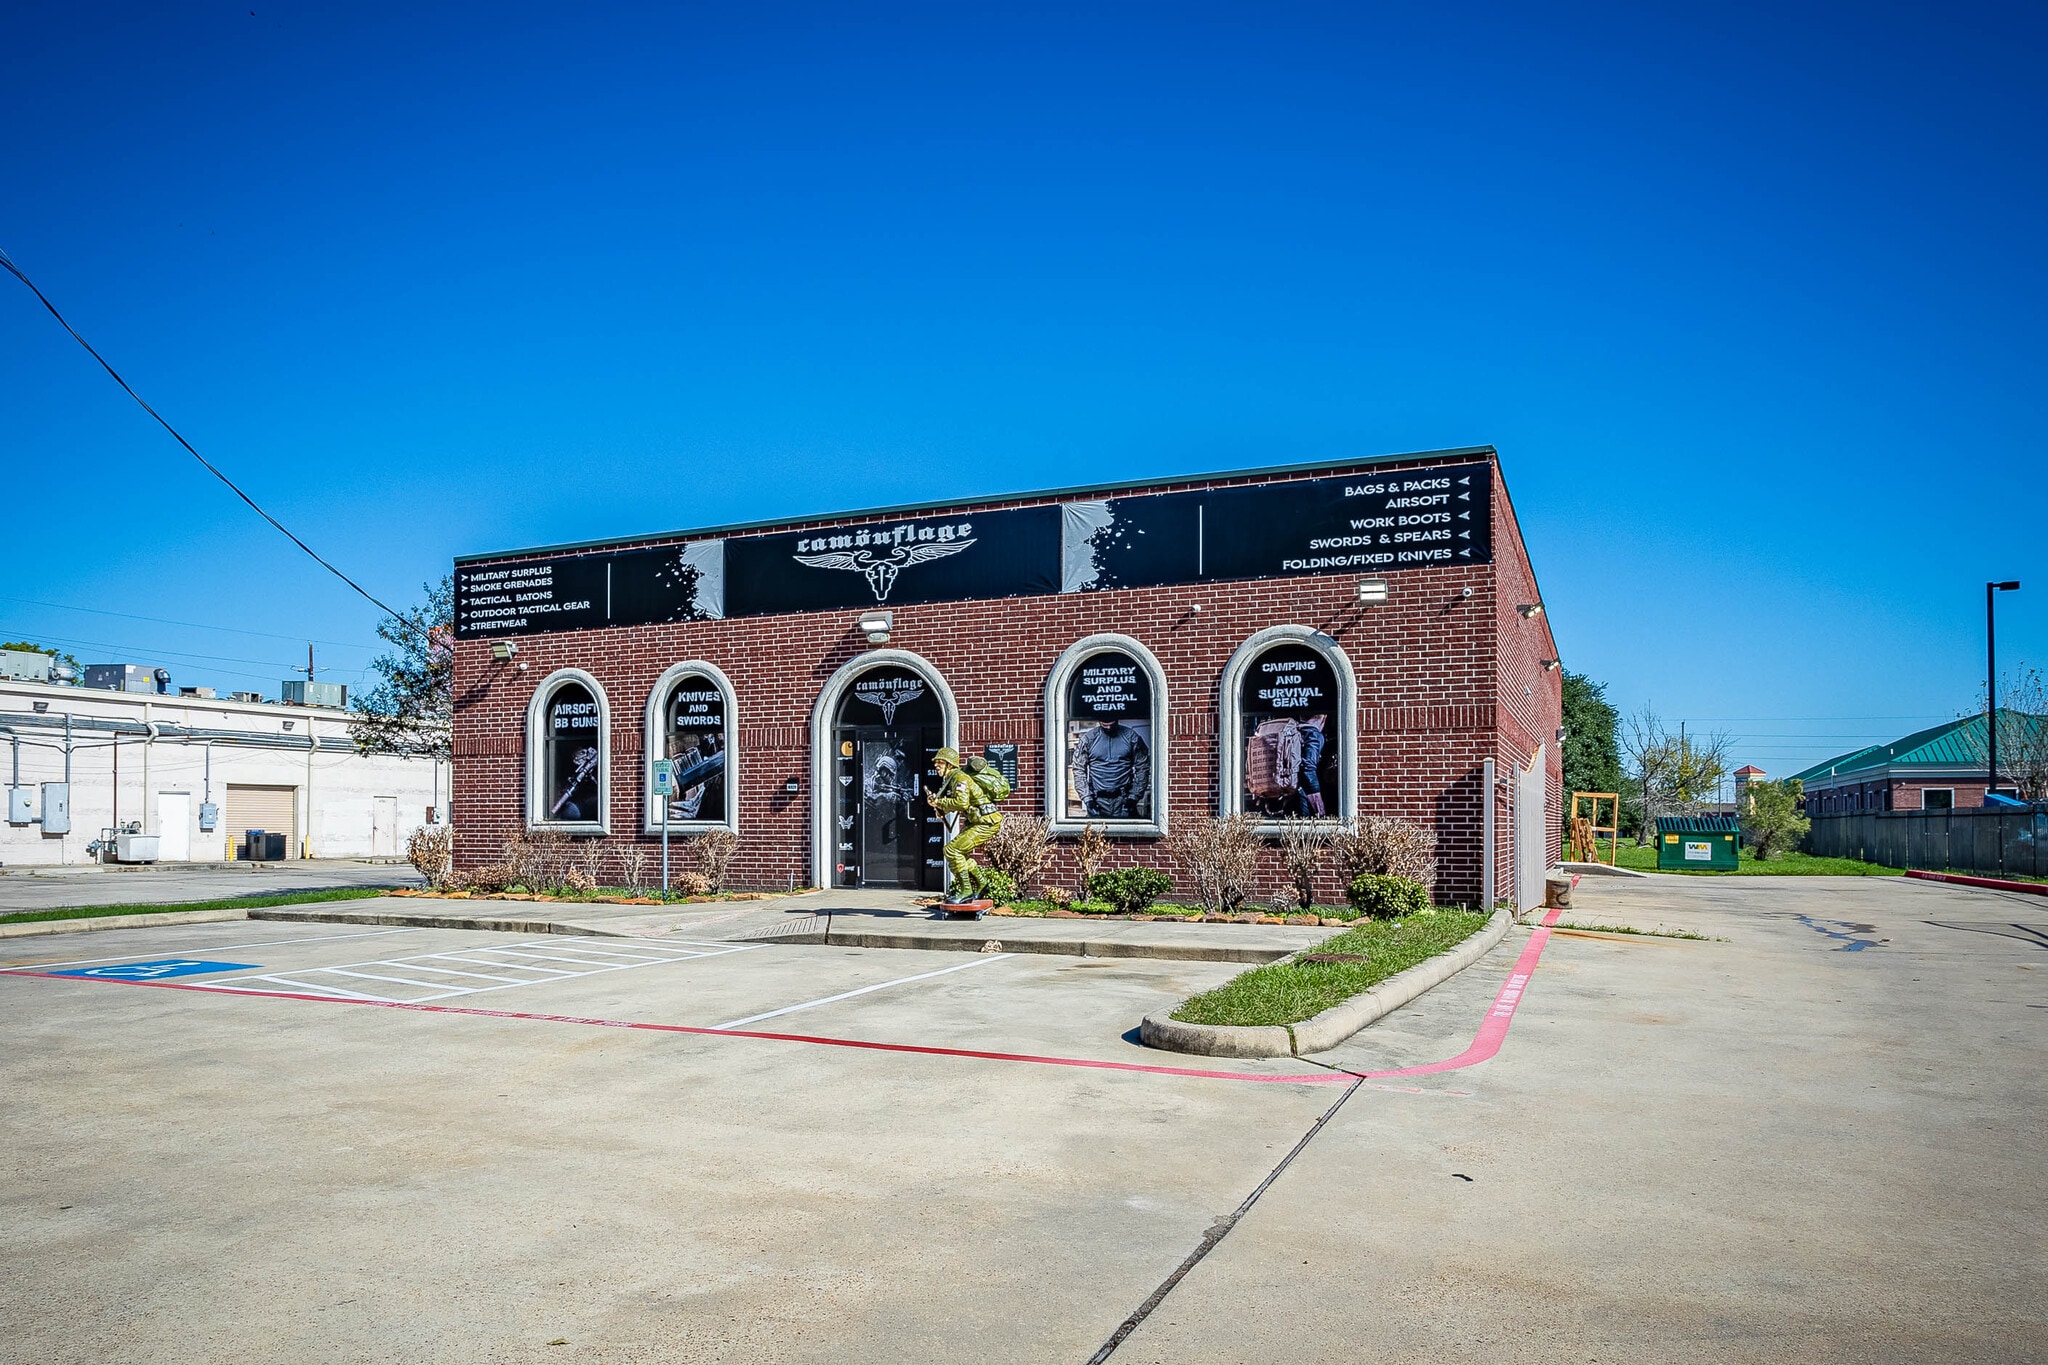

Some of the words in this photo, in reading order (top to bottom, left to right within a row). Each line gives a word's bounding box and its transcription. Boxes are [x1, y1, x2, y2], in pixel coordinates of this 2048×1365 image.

[1345, 484, 1385, 497] BAGS
[1388, 483, 1400, 493] &
[1403, 478, 1450, 491] PACKS
[1385, 494, 1450, 509] AIRSOFT
[1350, 517, 1395, 529] WORK
[1398, 512, 1451, 525] BOOTS
[1309, 535, 1371, 549] SWORDS
[1379, 534, 1391, 544] &
[1394, 529, 1452, 542] SPEARS
[1282, 552, 1394, 570] FOLDING/FIXED
[1398, 548, 1452, 561] KNIVES
[470, 571, 510, 582] MILITARY
[511, 566, 552, 578] SURPLUS
[470, 582, 502, 593] SMOKE
[503, 577, 553, 590] GRENADES
[470, 595, 512, 606] TACTICAL
[516, 591, 553, 602] BATONS
[470, 608, 517, 619] OUTDOOR
[518, 603, 562, 615] TACTICAL
[563, 601, 591, 611] GEAR
[470, 619, 527, 631] STREETWEAR
[1083, 666, 1136, 676] MILITARY
[1261, 660, 1316, 672] CAMPING
[1083, 675, 1136, 685] SURPLUS
[1275, 675, 1302, 686] AND
[1097, 685, 1122, 694] AND
[1258, 687, 1323, 699] SURVIVAL
[678, 691, 721, 702] KNIVES
[1081, 694, 1138, 703] TACTICAL
[1272, 697, 1309, 708] GEAR
[688, 704, 708, 713] AND
[1093, 702, 1126, 711] GEAR
[554, 717, 569, 728] BB
[571, 716, 599, 728] GUNS
[677, 715, 721, 726] SWORDS
